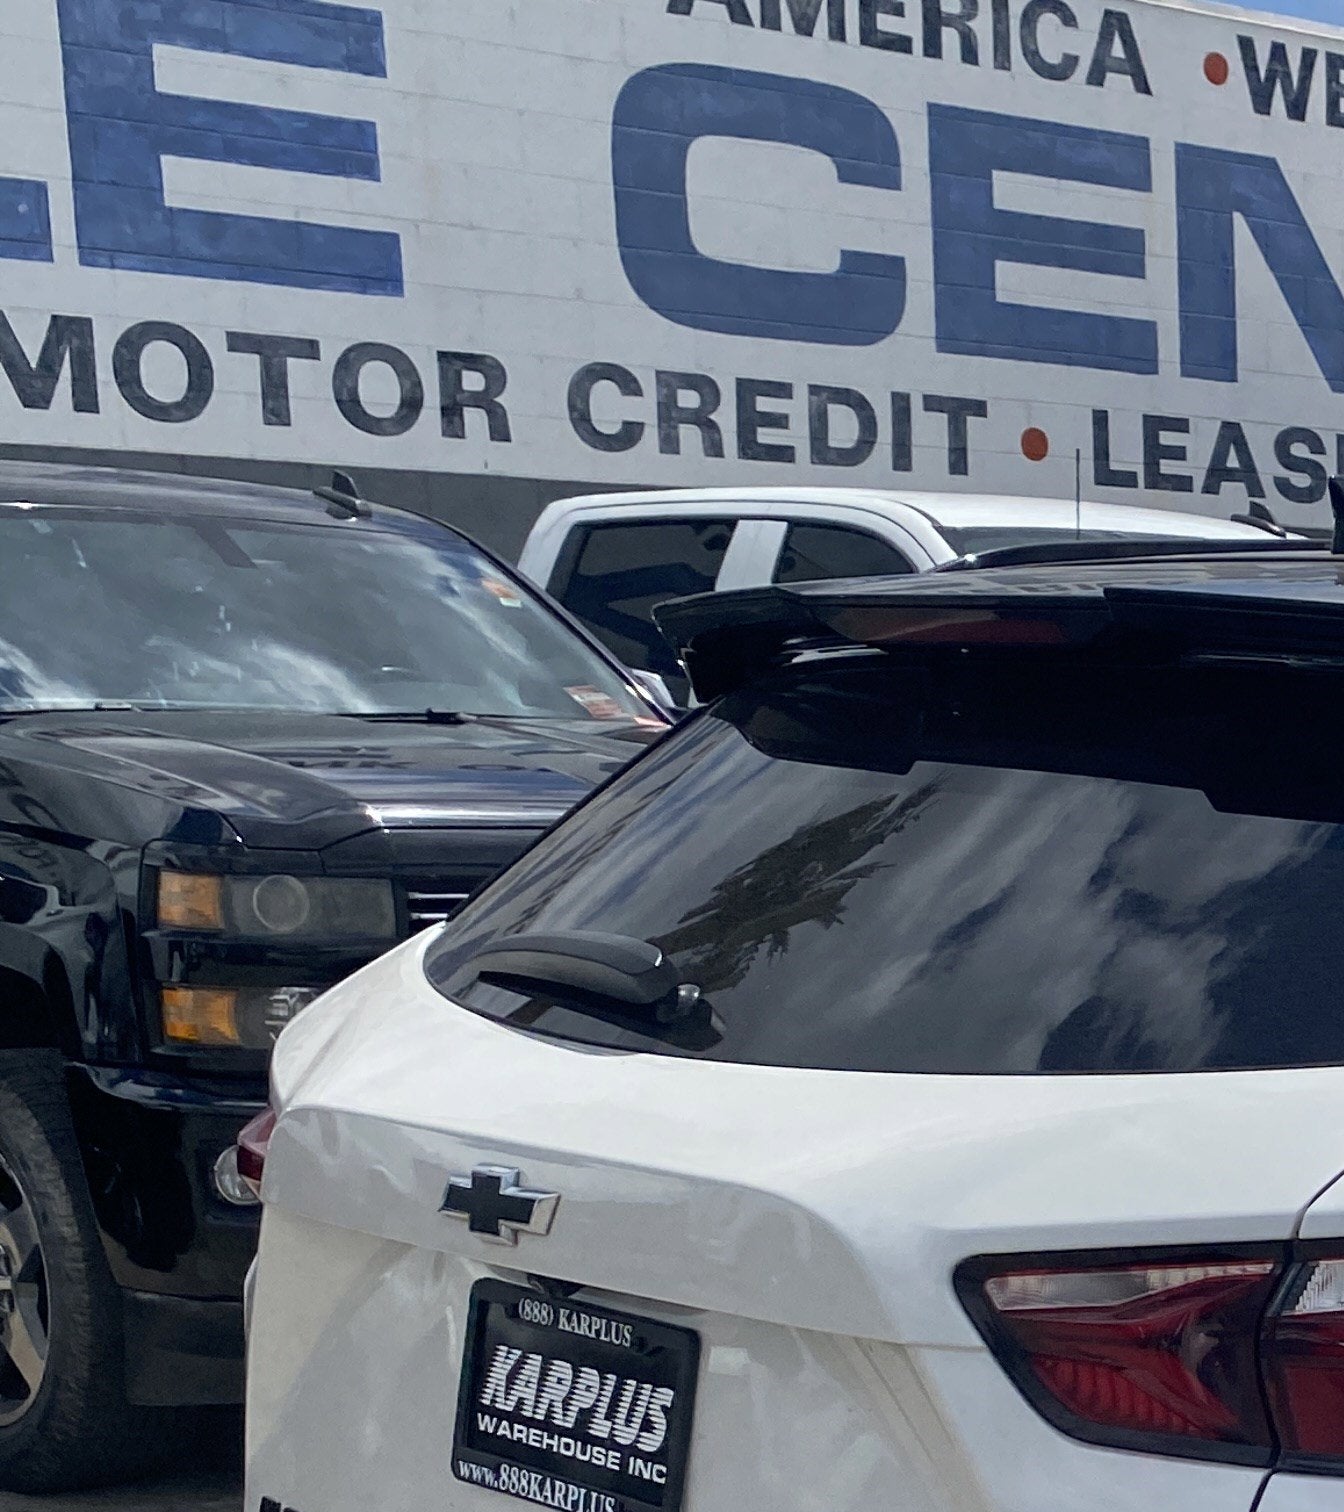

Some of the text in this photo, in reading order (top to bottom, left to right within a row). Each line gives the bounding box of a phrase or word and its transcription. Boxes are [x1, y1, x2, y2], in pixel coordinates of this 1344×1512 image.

[665, 0, 1152, 96] ERICA
[0, 0, 405, 298] E
[0, 310, 512, 442] MOTOR
[567, 361, 987, 475] CREDIT
[518, 1298, 634, 1347] (888) KARPLUS
[476, 1412, 667, 1484] WAREHOUSE INC
[479, 1345, 674, 1452] KARPLUS
